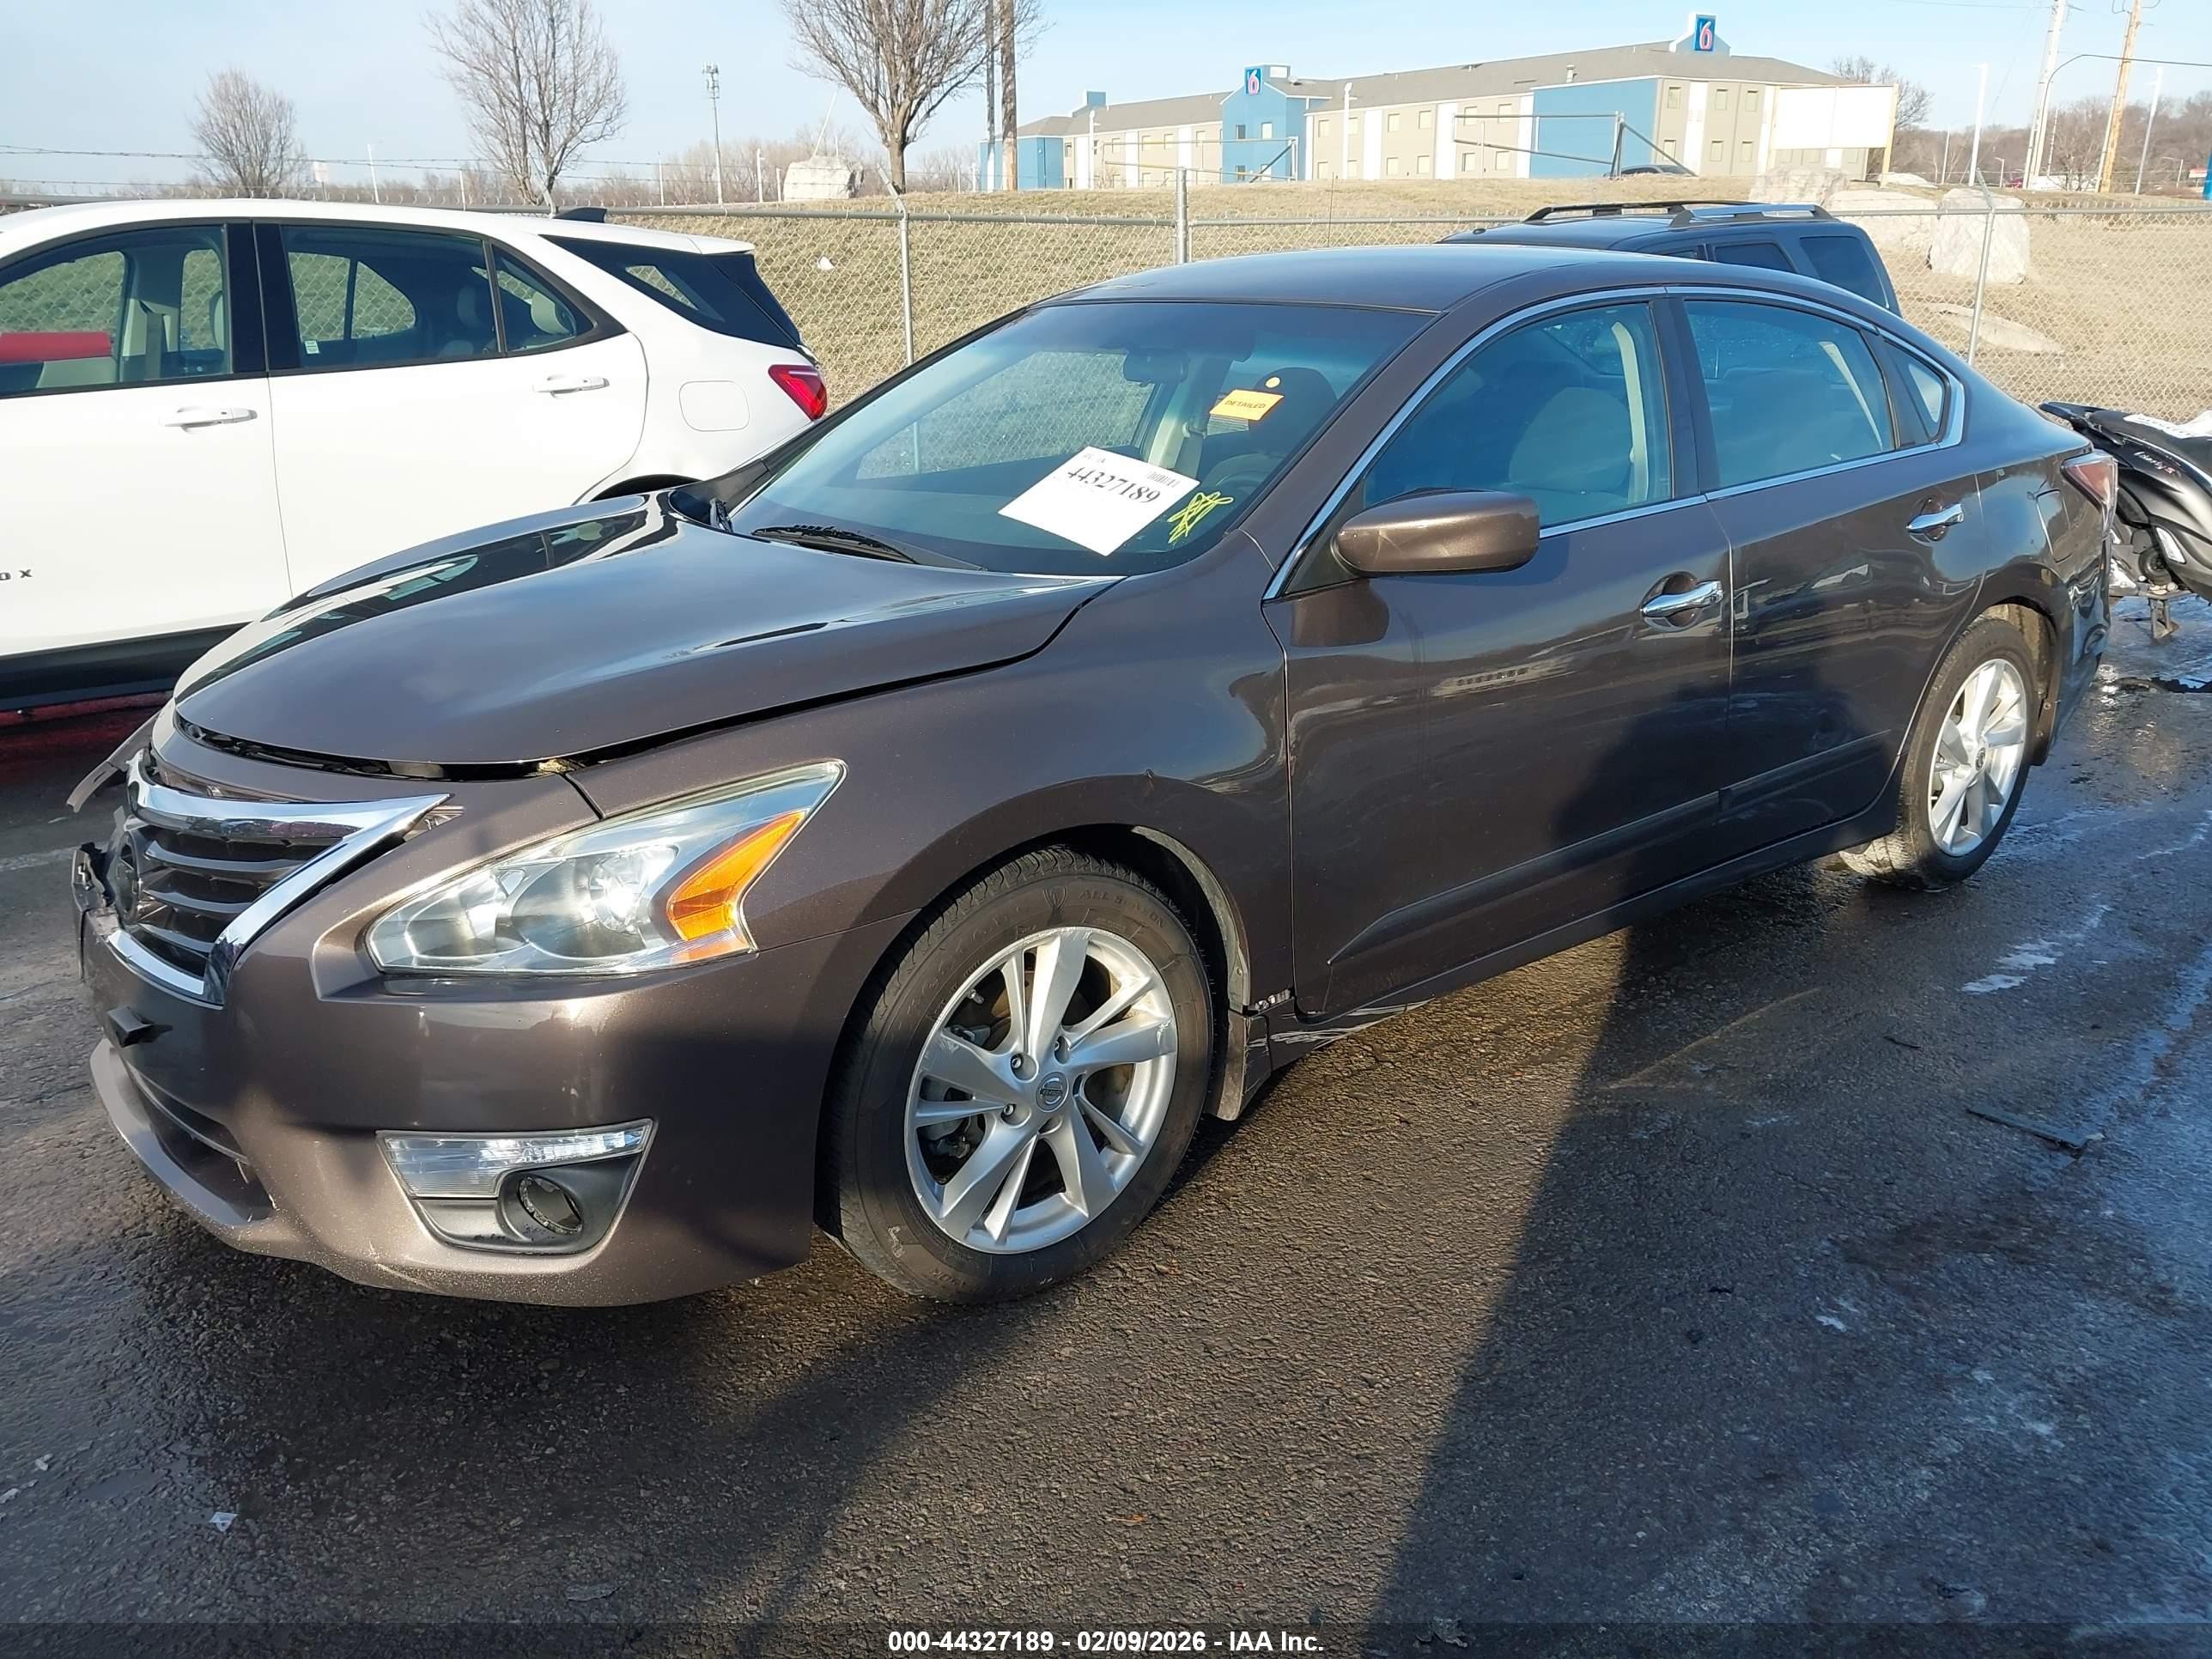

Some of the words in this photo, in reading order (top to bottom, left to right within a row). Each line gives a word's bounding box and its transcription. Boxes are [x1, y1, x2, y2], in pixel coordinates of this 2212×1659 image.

[1698, 21, 1713, 50] 6
[1248, 69, 1260, 95] 6
[1224, 400, 1267, 409] DETAILED
[1067, 466, 1161, 503] 44327189
